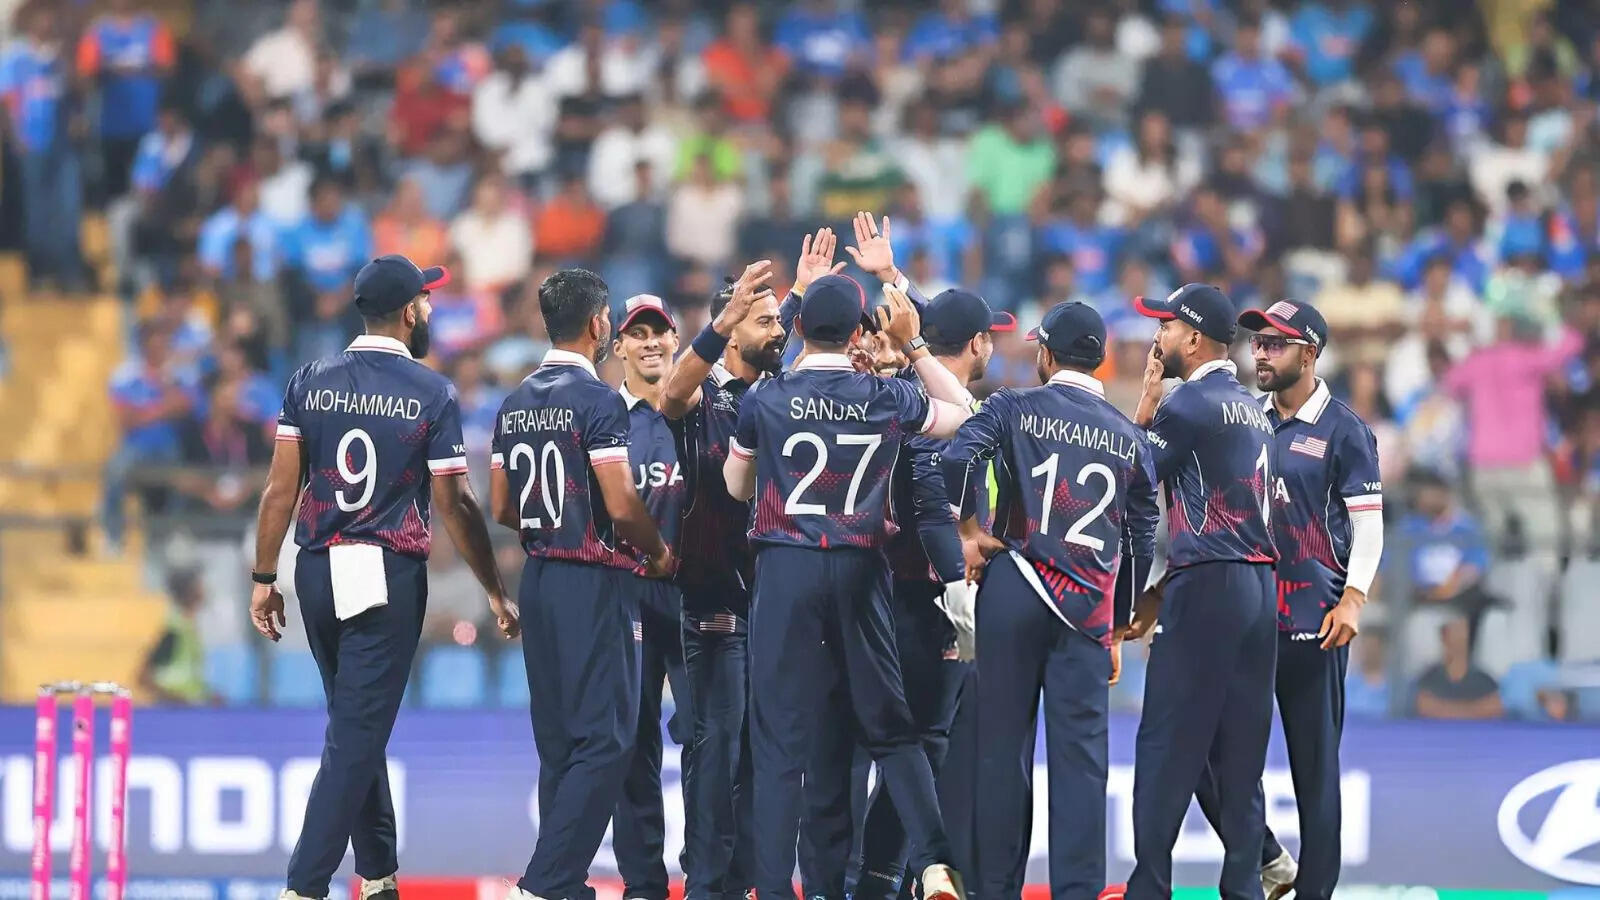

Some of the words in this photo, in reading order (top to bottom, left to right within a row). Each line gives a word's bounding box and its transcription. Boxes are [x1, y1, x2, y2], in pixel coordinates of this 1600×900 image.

[1180, 303, 1204, 324] YASHI
[305, 389, 421, 420] MOHAMMAD
[790, 396, 870, 423] SANJAY
[1019, 413, 1136, 463] MUKKAMALLA
[334, 428, 377, 512] 9
[509, 440, 565, 529] 20
[781, 431, 882, 516] 27
[1031, 452, 1116, 551] 12
